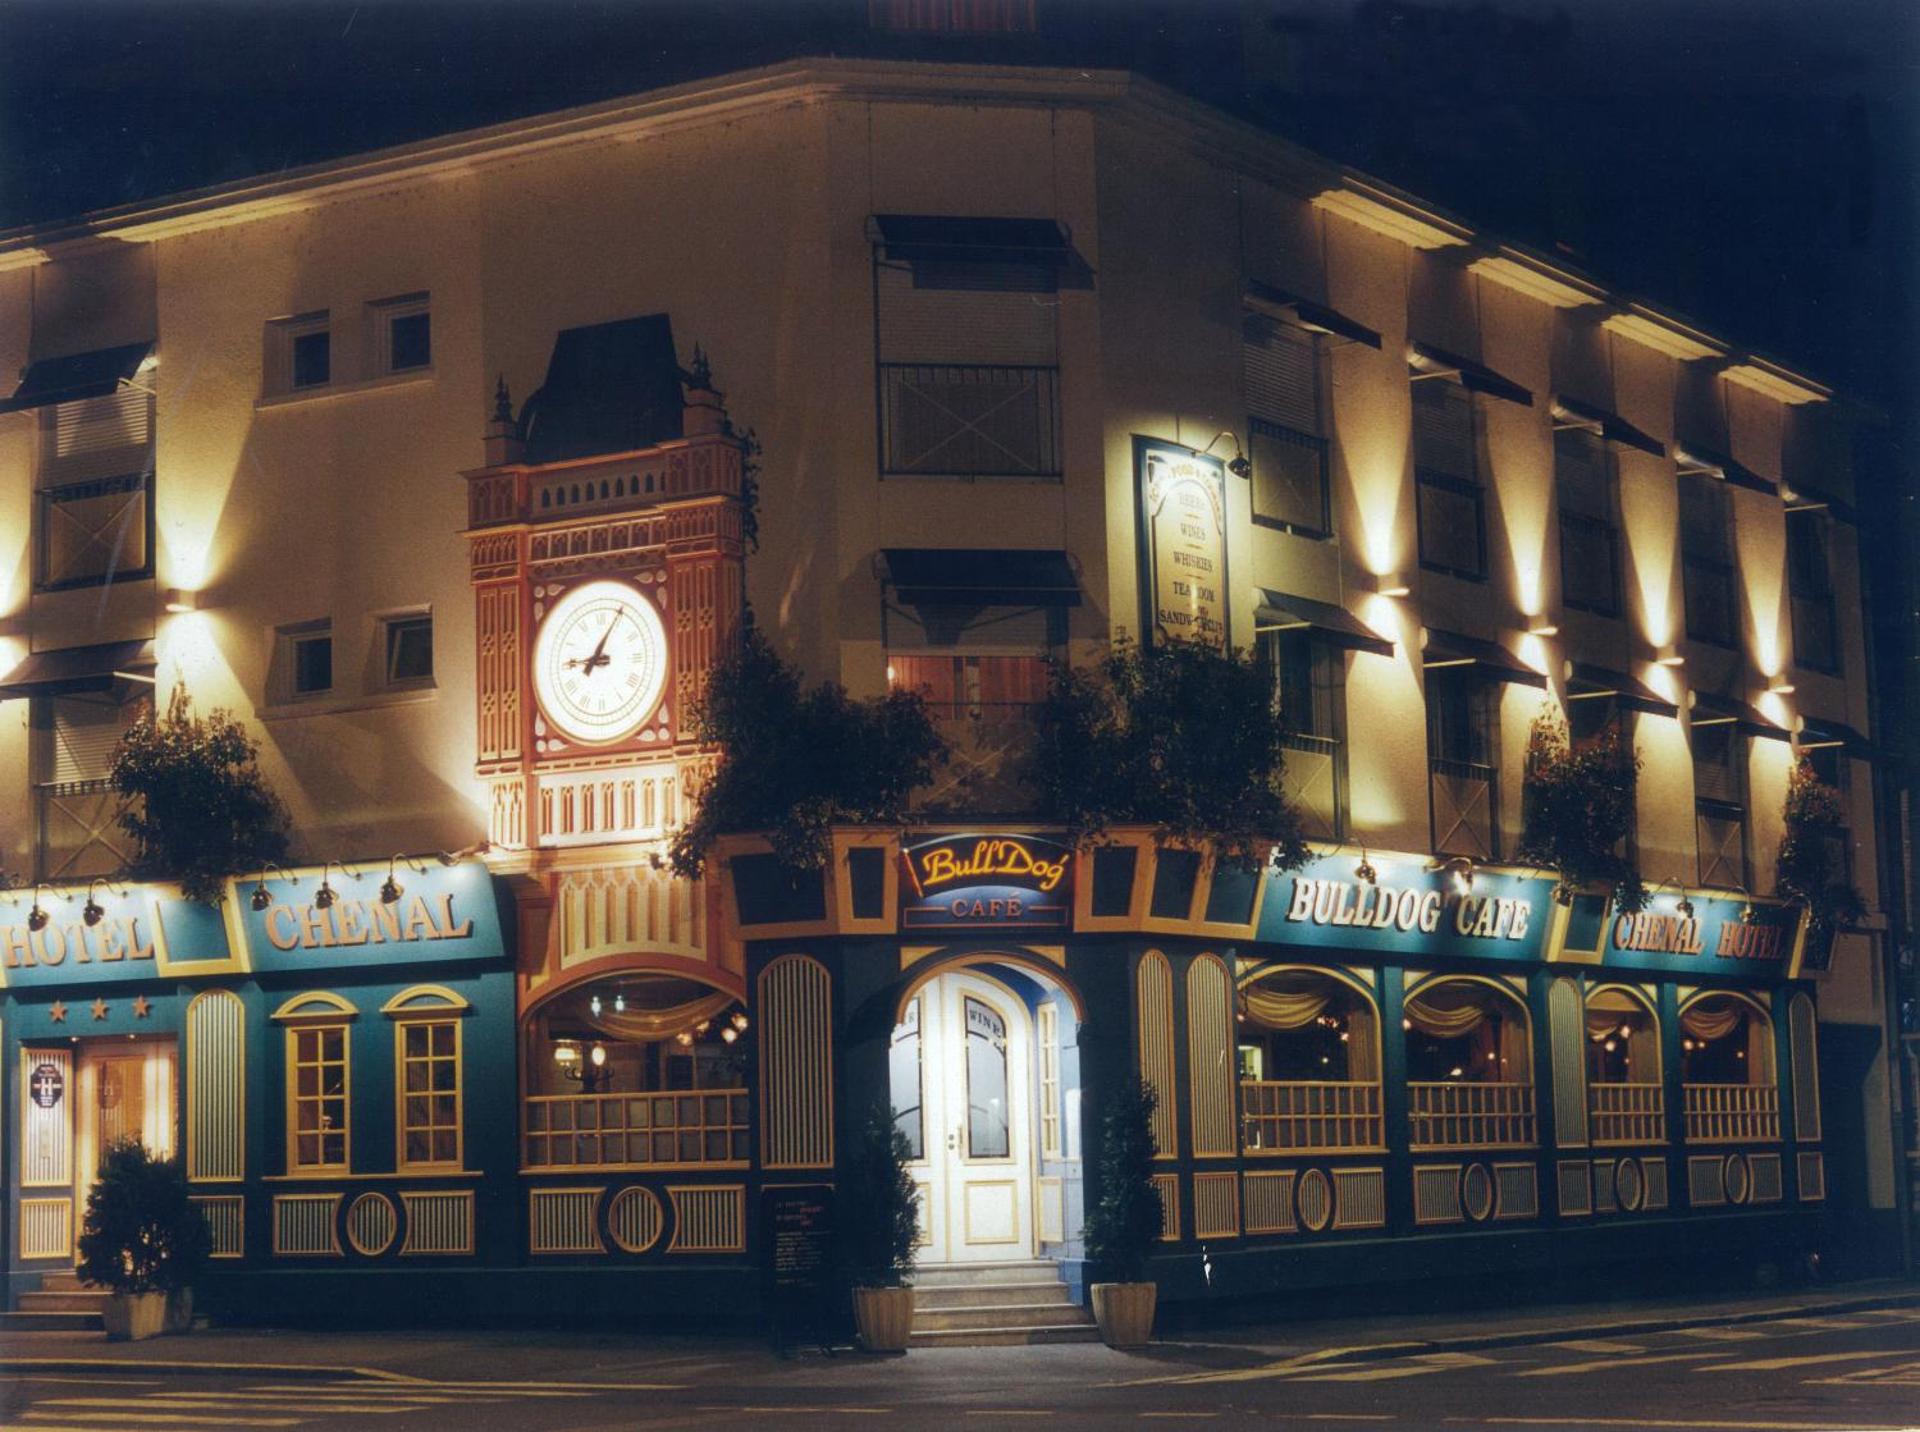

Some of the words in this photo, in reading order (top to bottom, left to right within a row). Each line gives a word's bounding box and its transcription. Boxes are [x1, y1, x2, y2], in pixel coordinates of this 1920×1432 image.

[265, 892, 473, 951] CHENAL
[951, 891, 1024, 918] CAFÉ
[1288, 877, 1441, 933] BULLDOG
[0, 917, 154, 968] HOTEL
[1613, 910, 1705, 956] CHENAL
[1716, 919, 1783, 960] HOTEL
